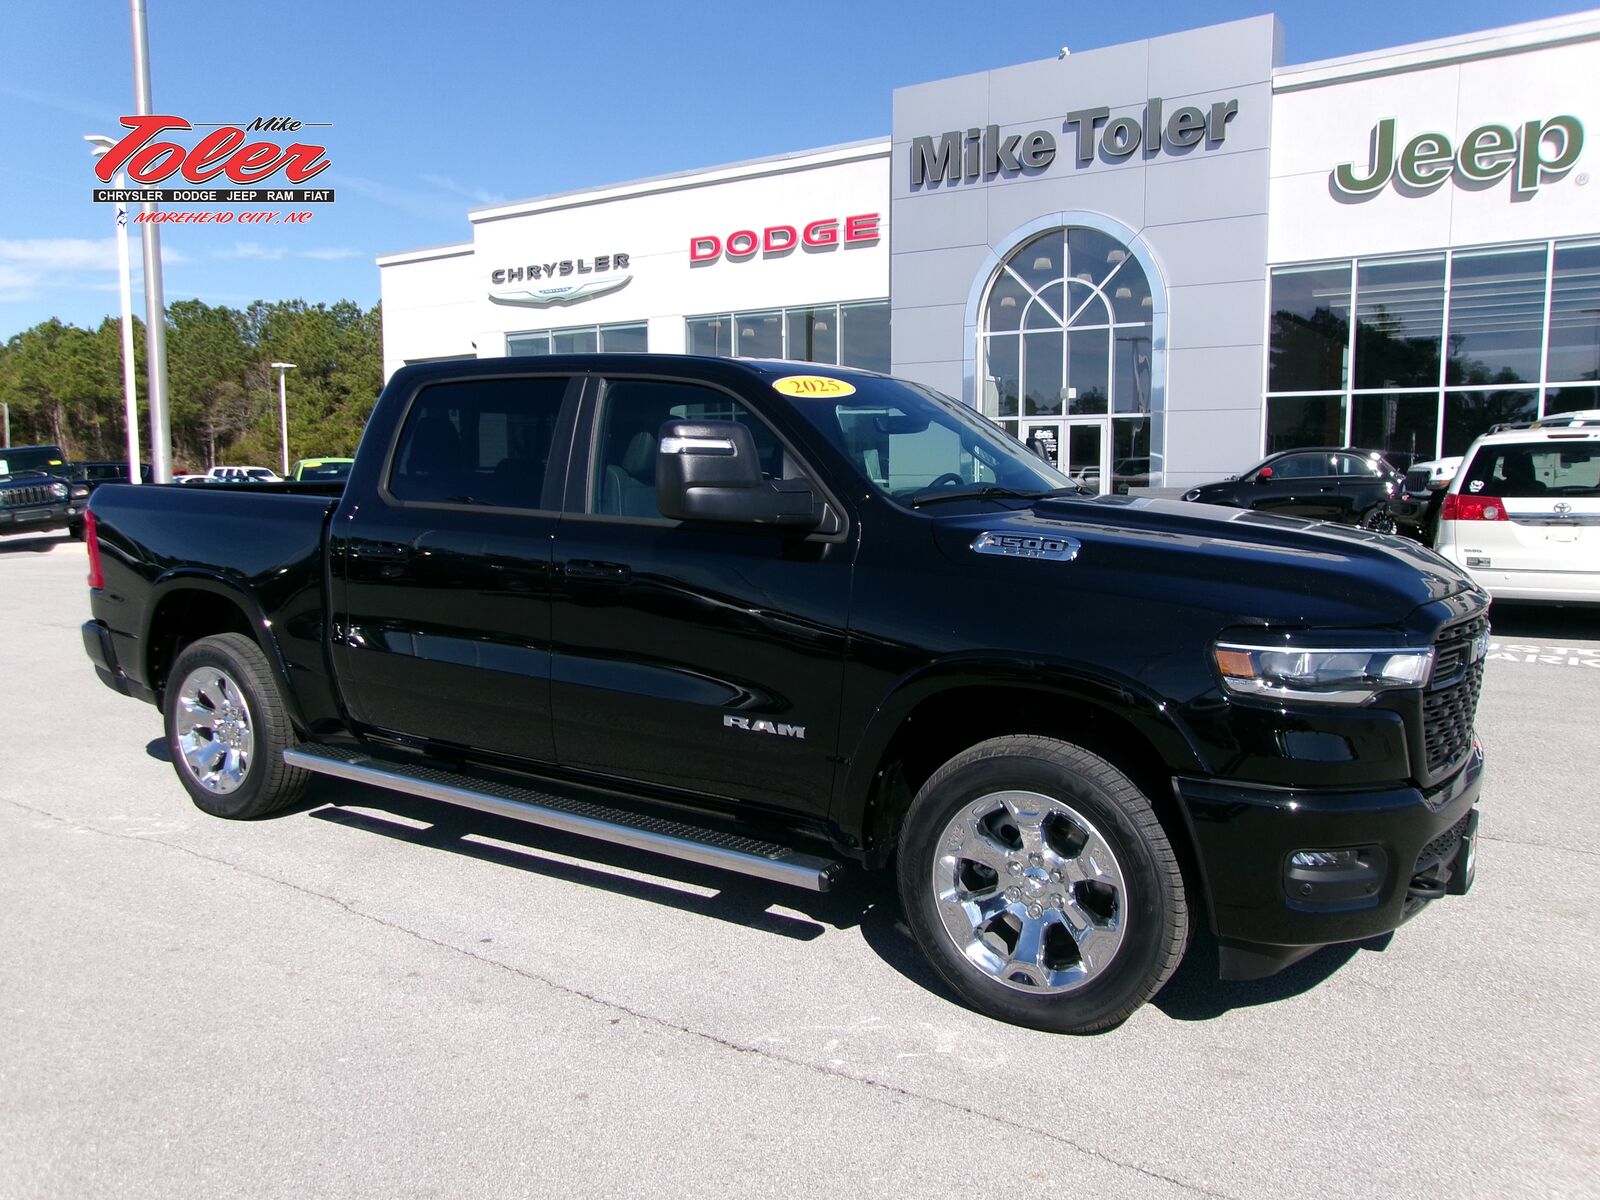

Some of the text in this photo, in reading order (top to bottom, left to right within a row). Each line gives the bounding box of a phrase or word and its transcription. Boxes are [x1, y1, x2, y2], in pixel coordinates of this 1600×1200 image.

[911, 96, 1238, 185] Mike Toler
[1333, 114, 1585, 194] Jeep
[689, 212, 881, 262] DODGE
[491, 253, 630, 285] CHRYSLER
[789, 379, 841, 394] 2025
[984, 535, 1064, 551] 1500
[723, 714, 806, 739] RAM
